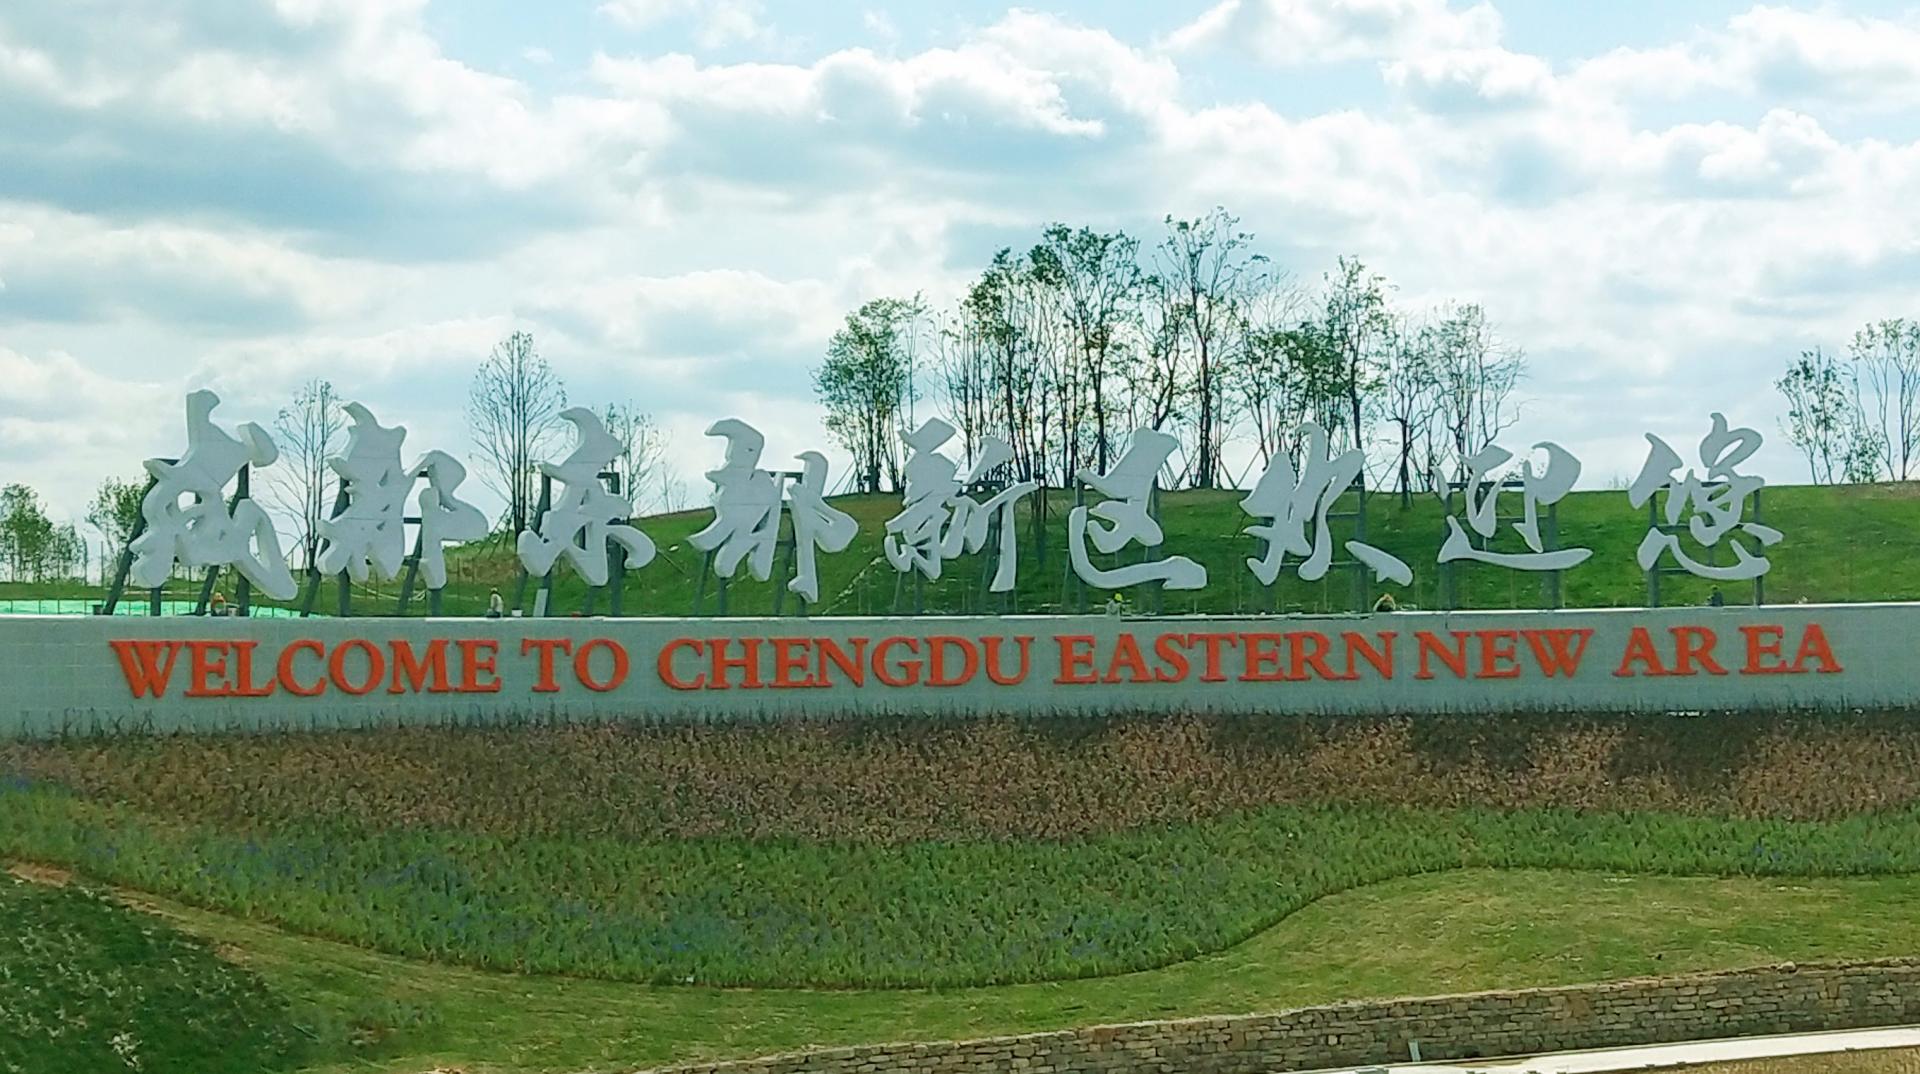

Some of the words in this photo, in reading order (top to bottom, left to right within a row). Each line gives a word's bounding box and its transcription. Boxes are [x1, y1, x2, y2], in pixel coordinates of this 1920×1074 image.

[110, 638, 501, 698] WELCOME
[522, 637, 629, 692] TO
[657, 635, 1035, 690] CHENGDU
[1054, 630, 1397, 684] EASTERN
[1415, 627, 1594, 679] NEW
[1614, 623, 1843, 676] AREA
